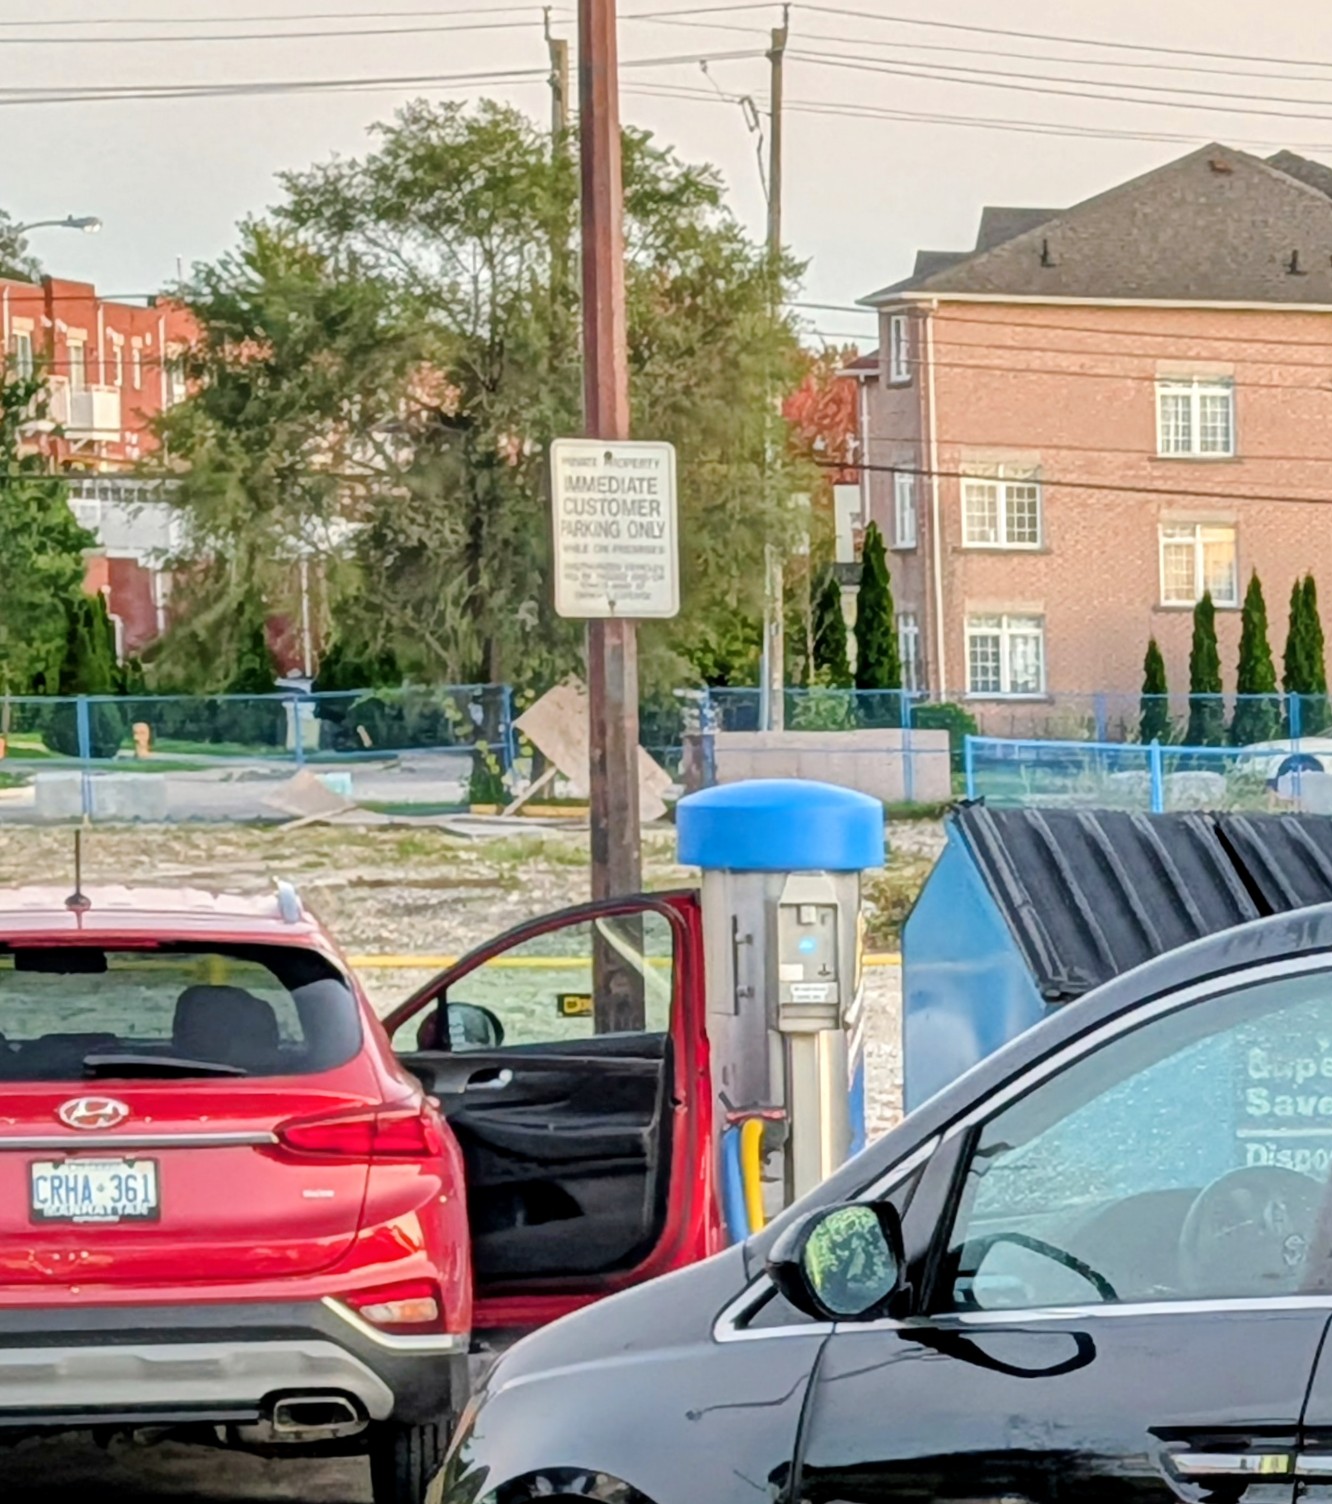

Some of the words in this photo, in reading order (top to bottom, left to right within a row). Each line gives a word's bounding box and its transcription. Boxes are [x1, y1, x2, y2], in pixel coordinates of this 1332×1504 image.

[564, 475, 659, 495] IMMEDIATE
[563, 497, 661, 517] CUSTOMER
[560, 519, 621, 539] PARKING
[627, 520, 666, 539] ONLY
[35, 1174, 93, 1205] CRHA
[109, 1174, 151, 1204] 361
